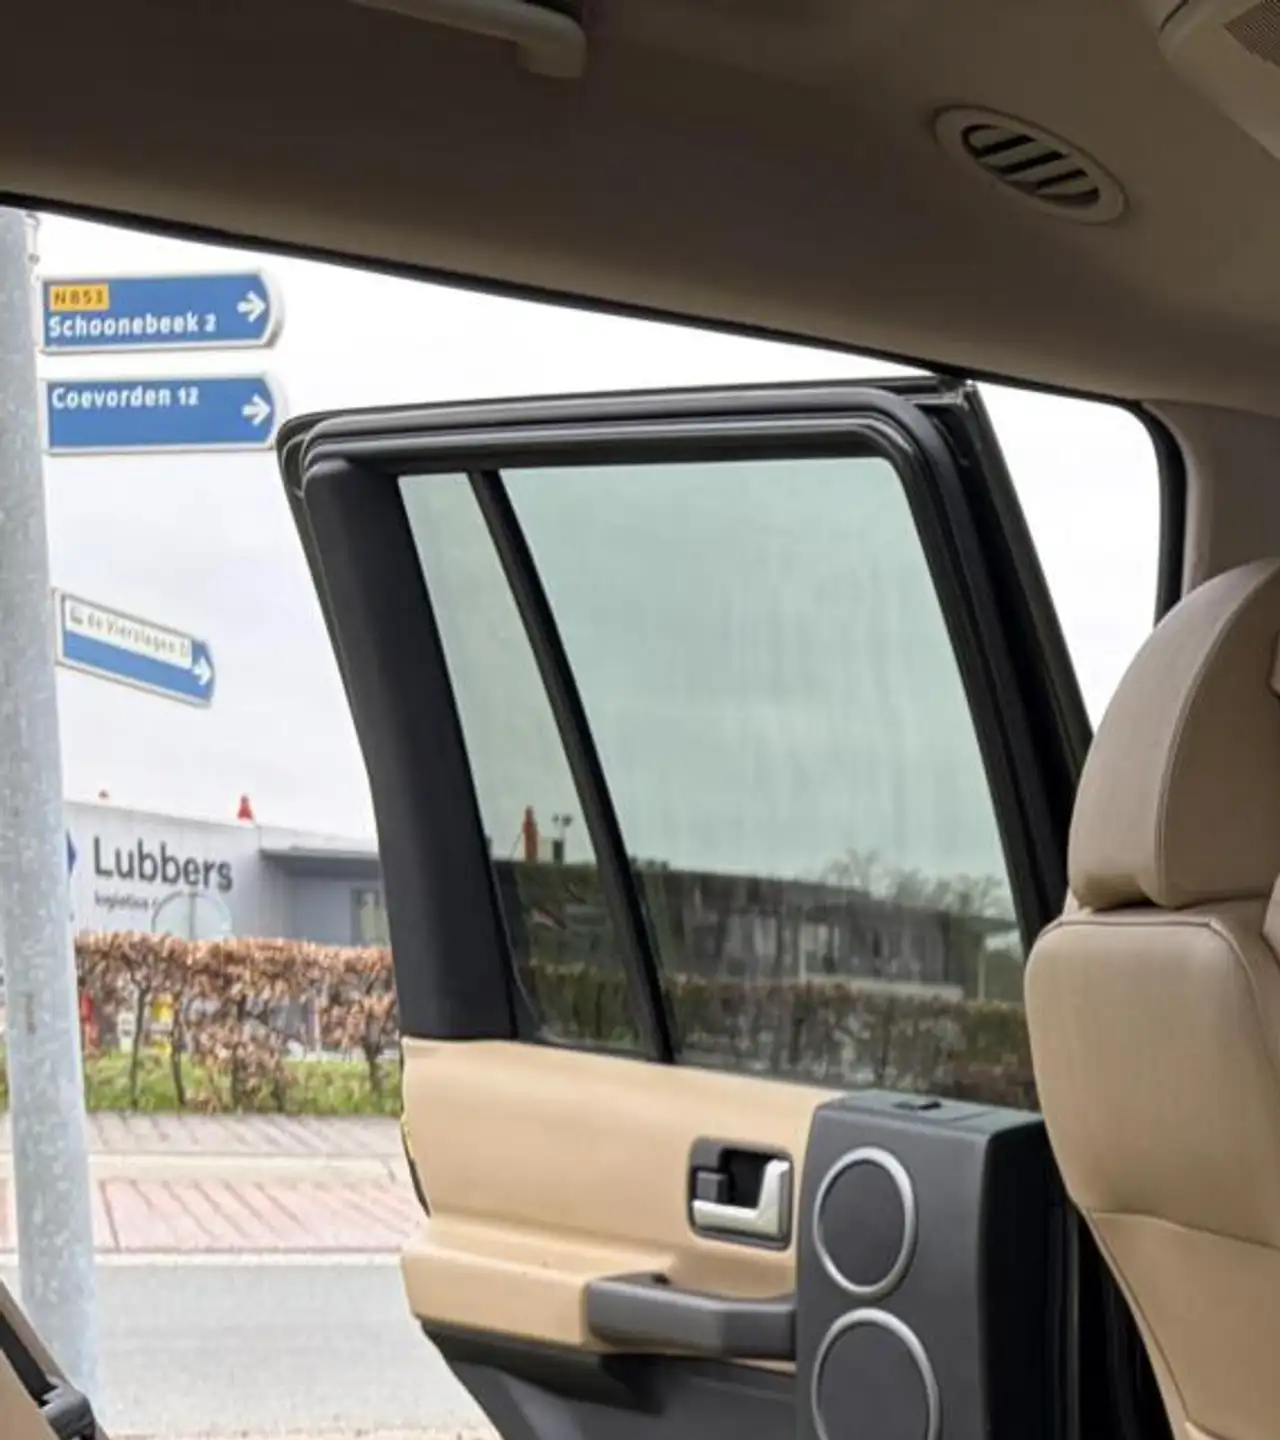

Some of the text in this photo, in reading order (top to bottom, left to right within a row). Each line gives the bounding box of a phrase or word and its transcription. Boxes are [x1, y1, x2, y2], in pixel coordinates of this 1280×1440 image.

[49, 310, 217, 338] Schoonebeek 2
[51, 385, 200, 410] Coevorden 12
[93, 835, 233, 893] Lubbers
